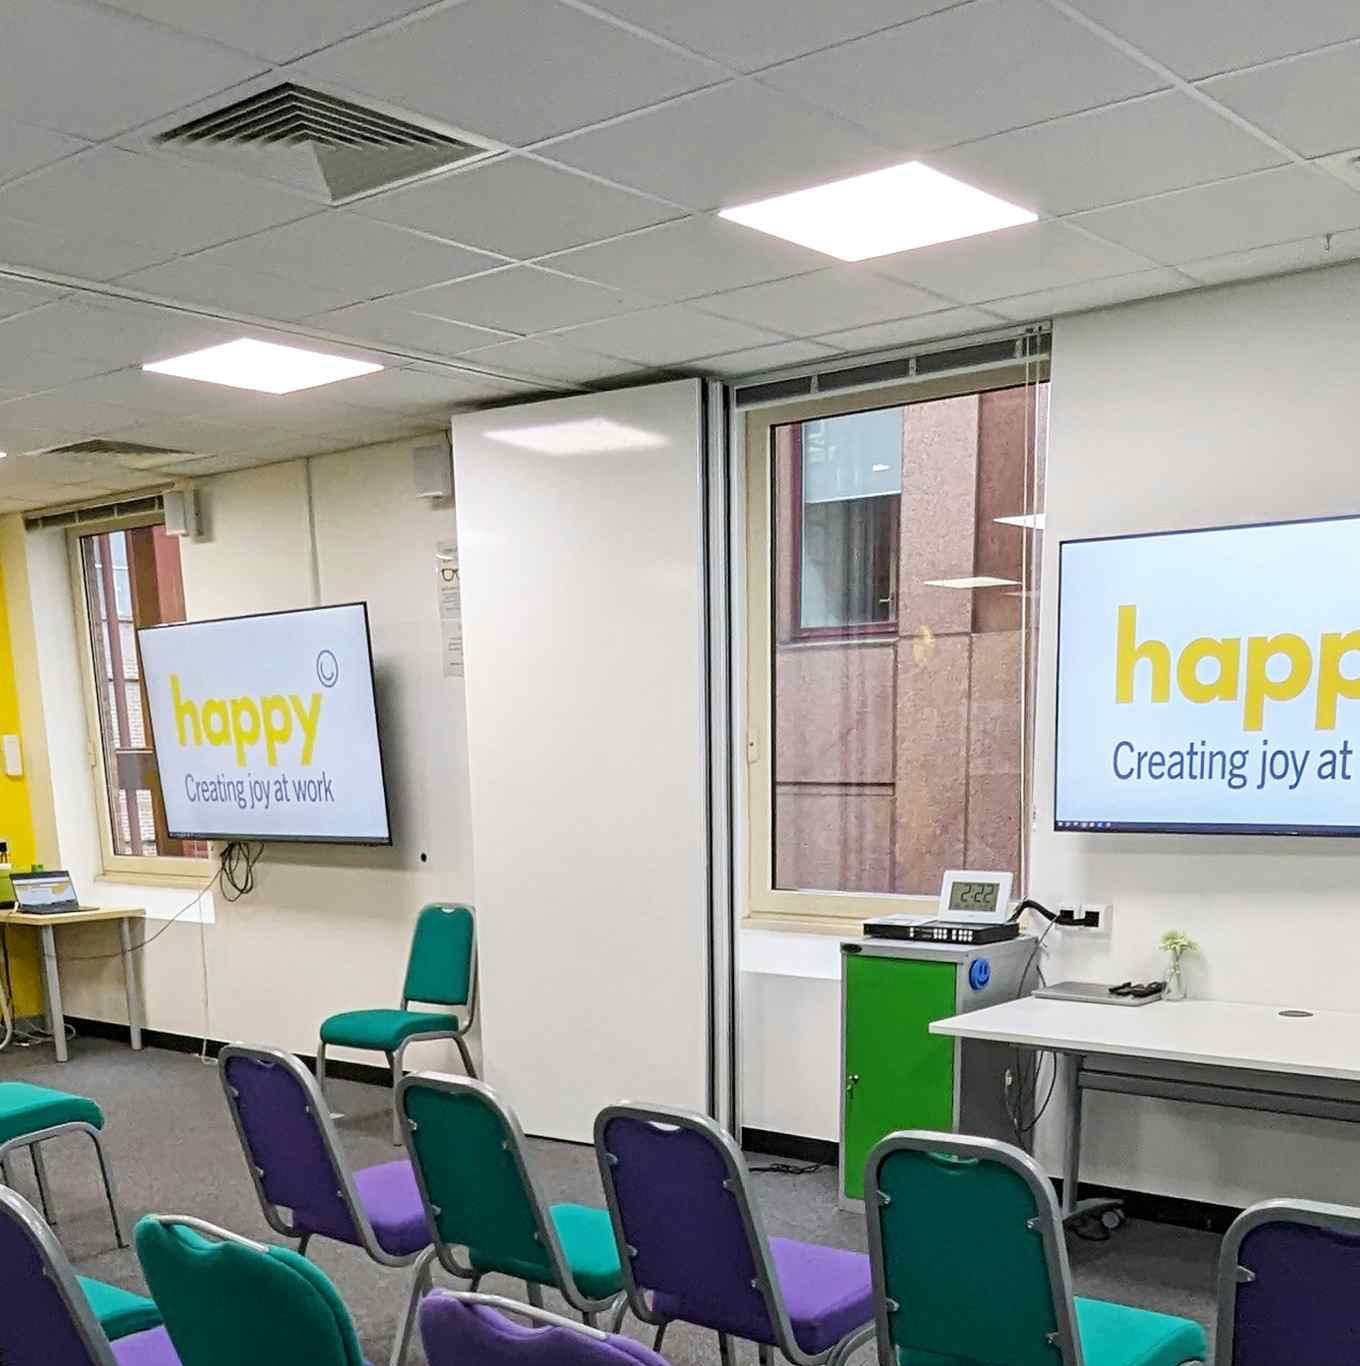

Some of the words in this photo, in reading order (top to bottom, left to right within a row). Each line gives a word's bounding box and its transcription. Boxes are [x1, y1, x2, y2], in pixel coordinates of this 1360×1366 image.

[168, 671, 323, 769] happy
[184, 771, 248, 810] Creating
[247, 772, 271, 810] joy
[273, 773, 291, 803] at
[292, 770, 336, 803] work
[1112, 740, 1250, 790] Creating
[1256, 738, 1310, 791] joy
[1316, 739, 1353, 781] at
